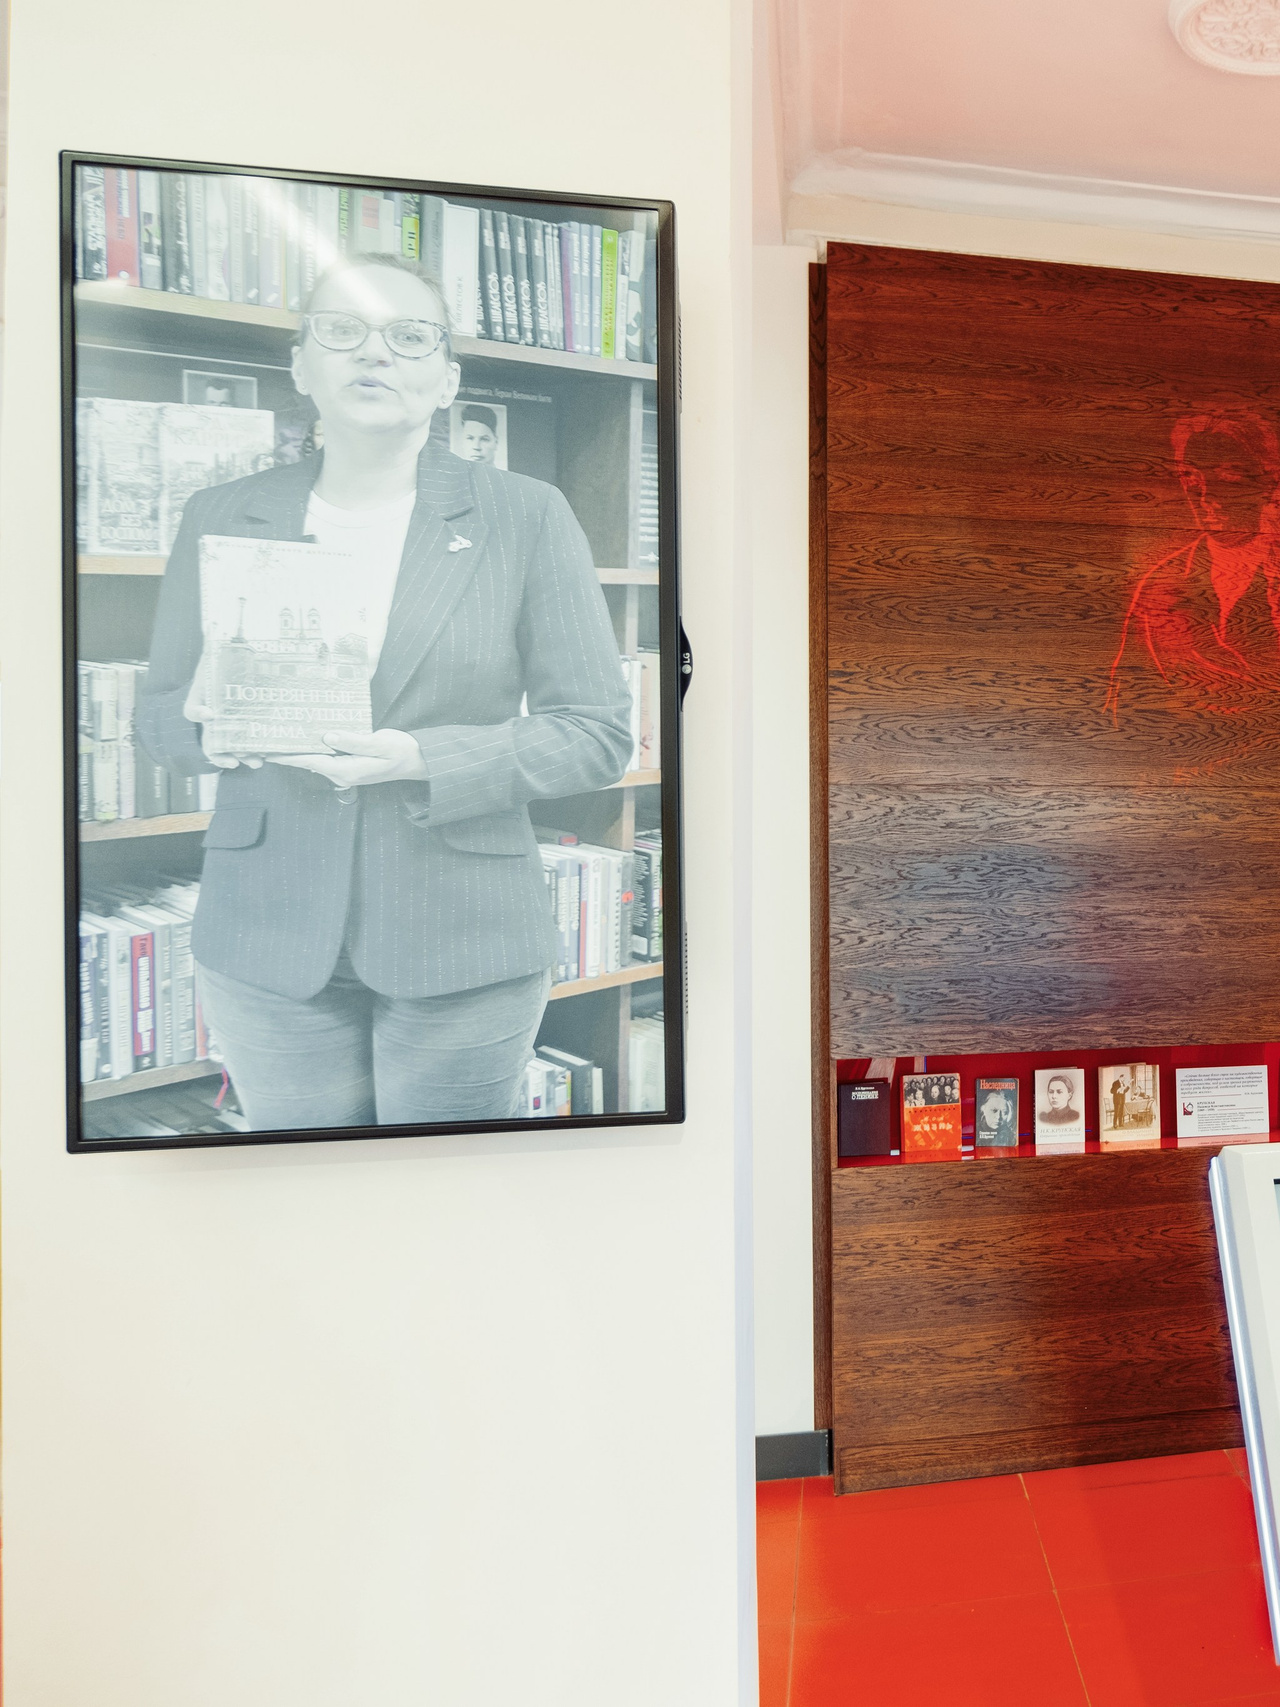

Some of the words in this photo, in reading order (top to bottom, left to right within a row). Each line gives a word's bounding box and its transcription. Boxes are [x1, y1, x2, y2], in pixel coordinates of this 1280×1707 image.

[682, 652, 690, 664] LG
[225, 684, 354, 704] ПОТЕРЯННЫЕ
[270, 707, 363, 723] ДЕВУШКИ
[250, 722, 309, 739] РИМА
[980, 1080, 1016, 1091] Наследница
